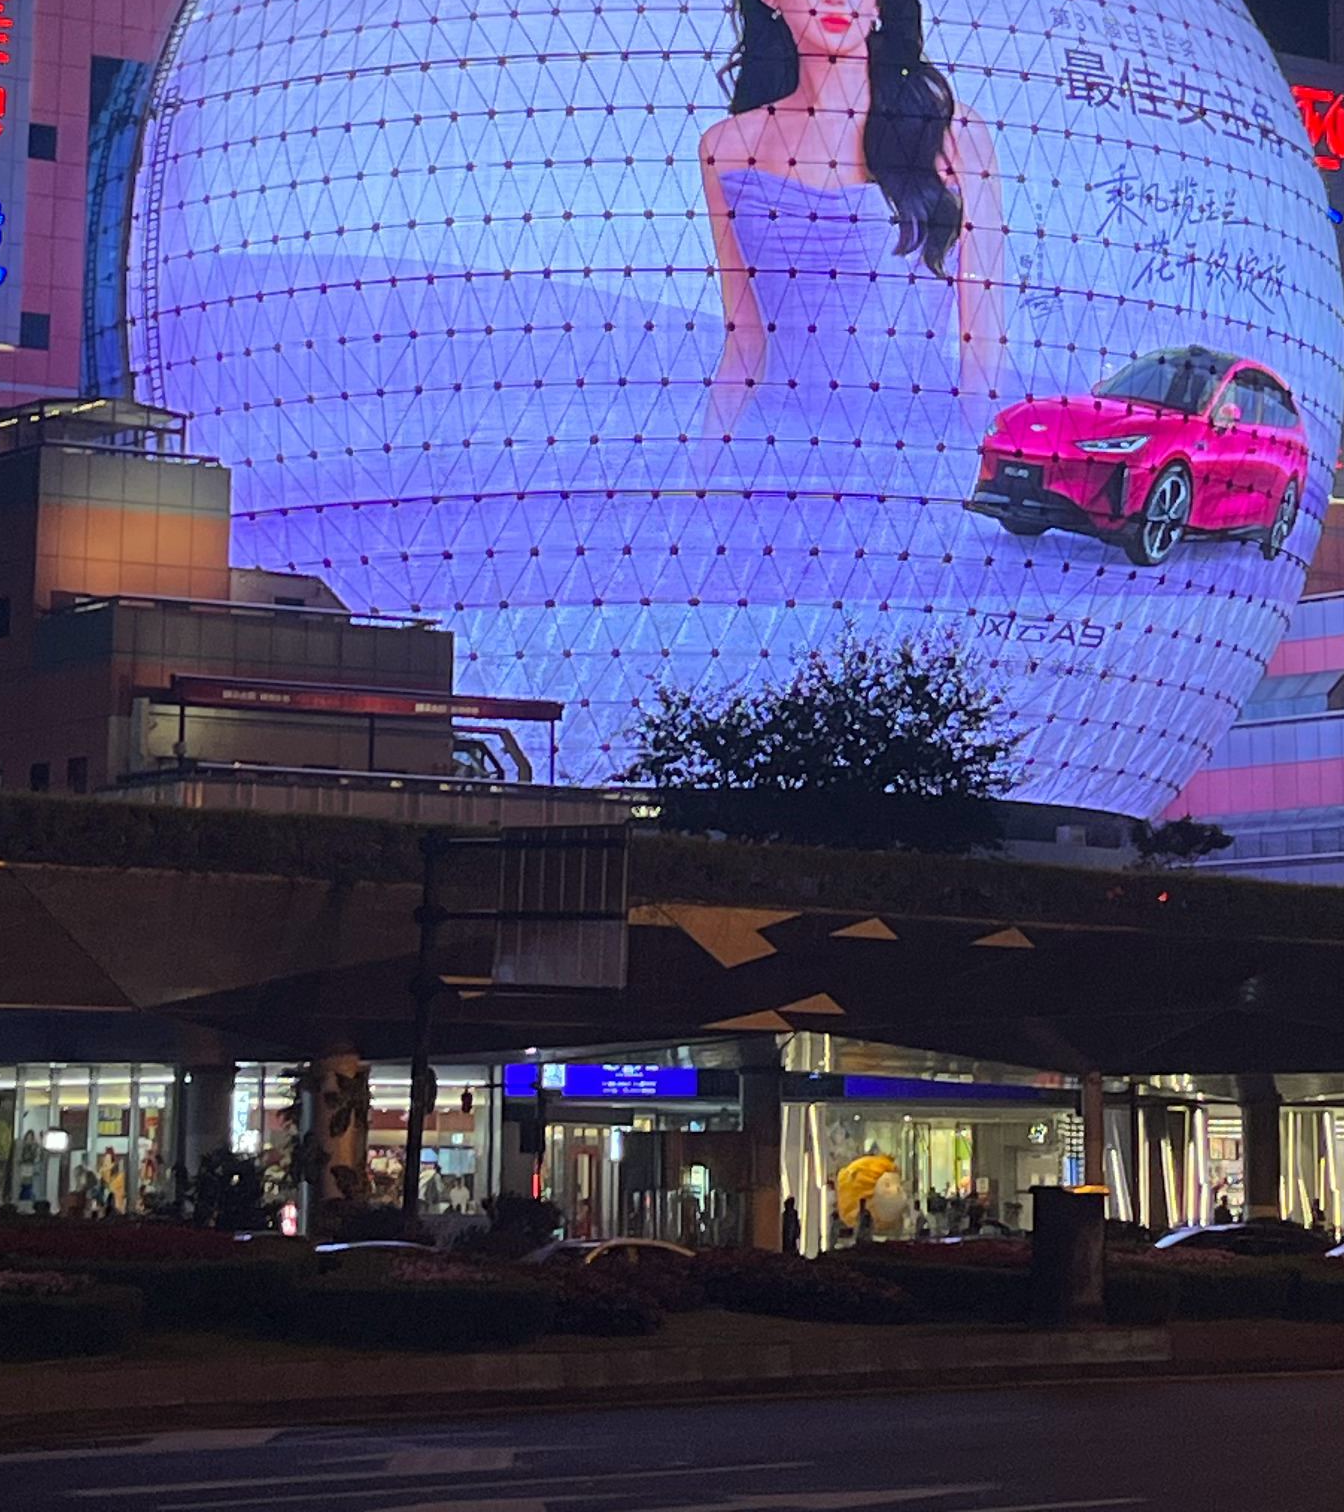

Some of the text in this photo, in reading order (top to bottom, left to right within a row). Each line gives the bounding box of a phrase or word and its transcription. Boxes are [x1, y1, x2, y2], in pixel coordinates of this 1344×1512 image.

[1060, 47, 1284, 159] 最佳女主角
[976, 612, 1106, 648] 风云A9
